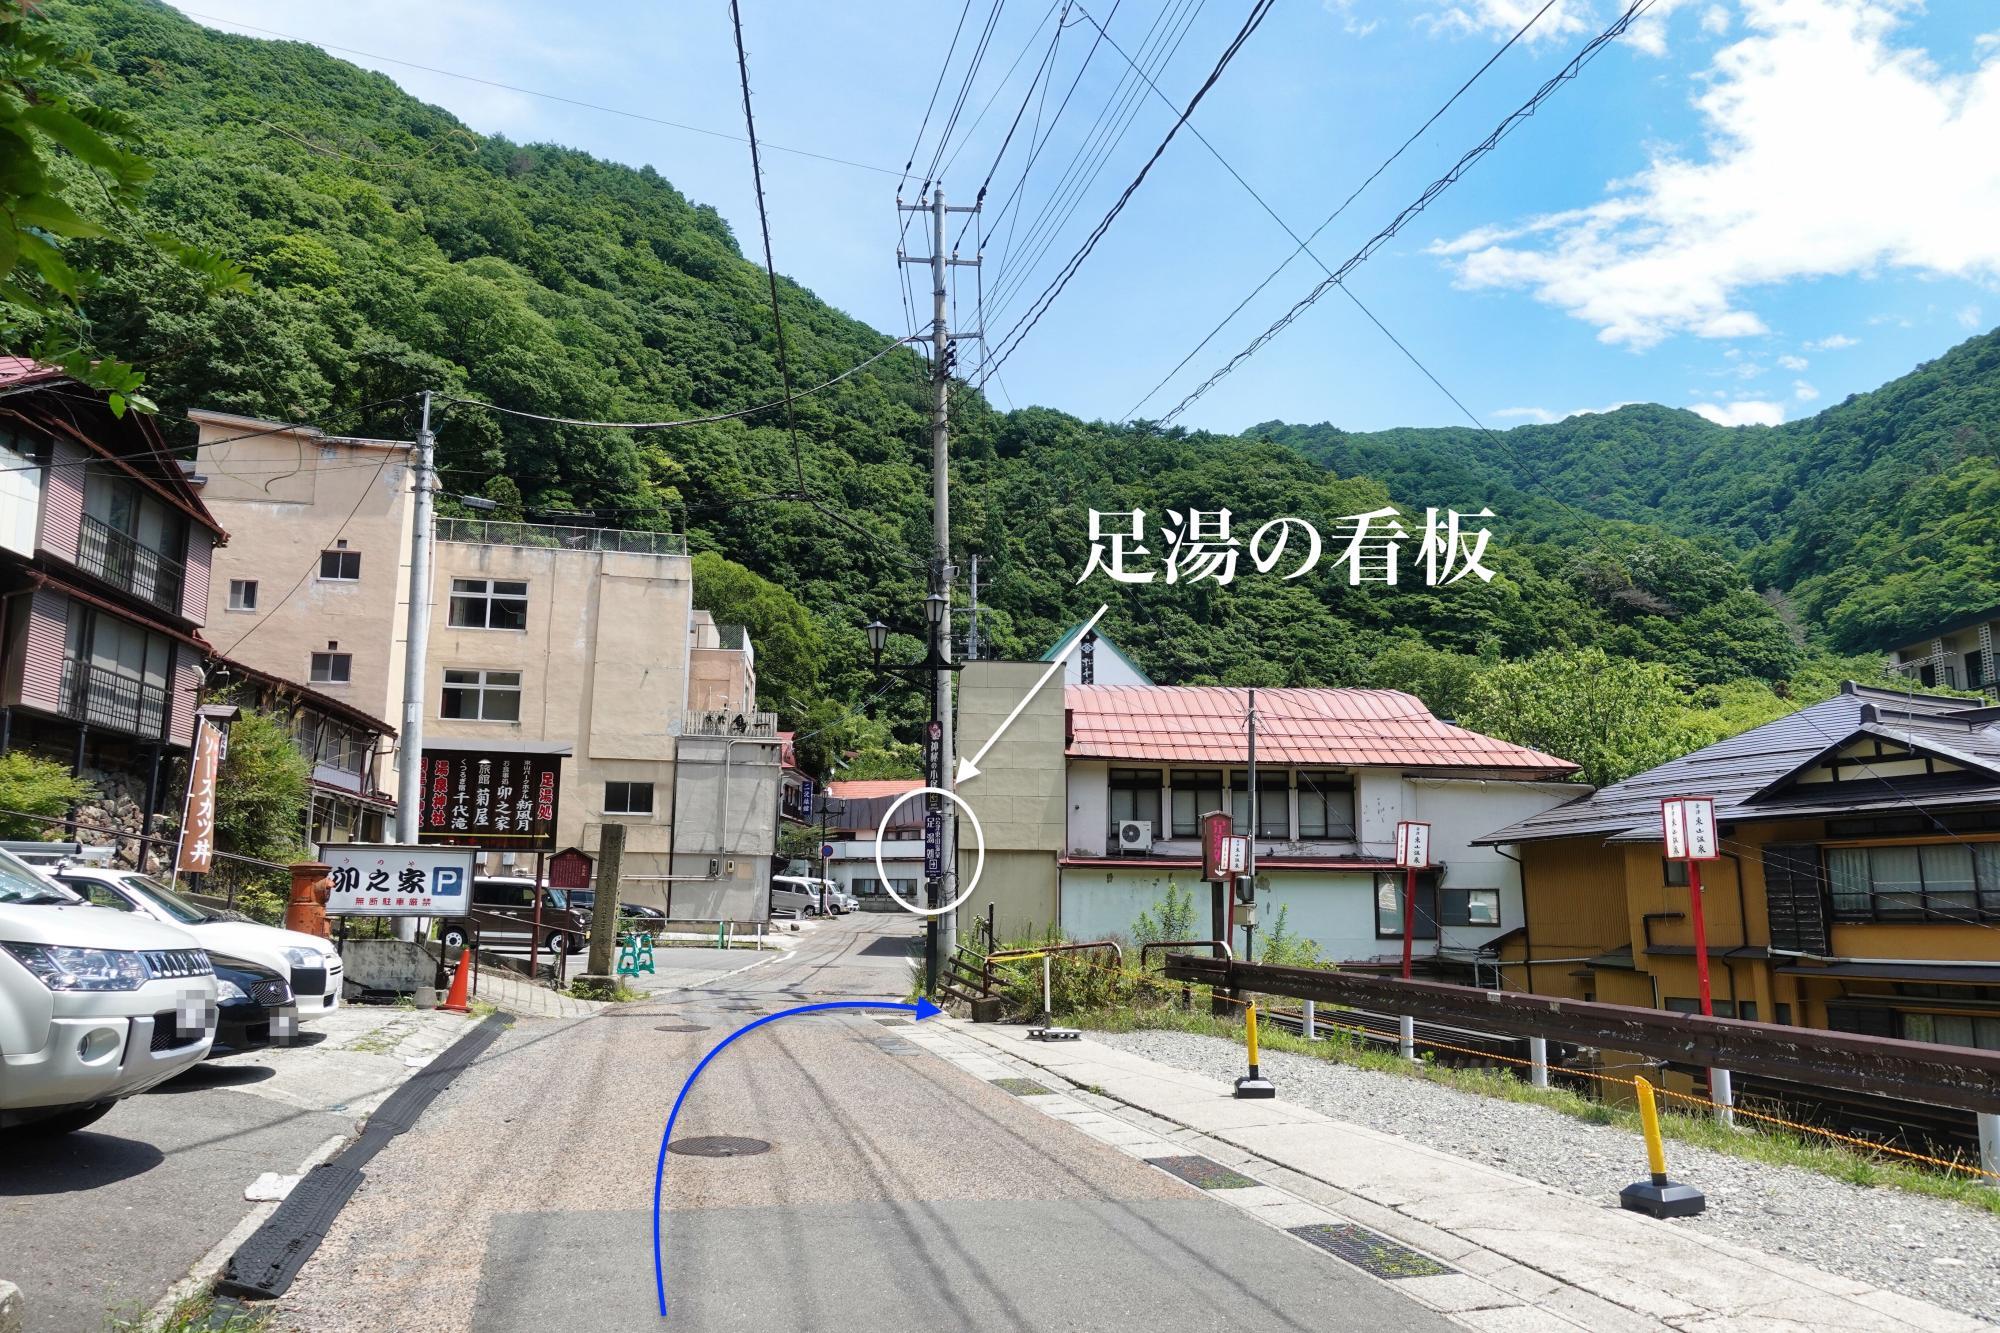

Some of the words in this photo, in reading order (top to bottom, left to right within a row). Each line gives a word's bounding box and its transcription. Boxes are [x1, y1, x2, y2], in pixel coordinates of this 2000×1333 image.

[478, 764, 491, 784] 旅館
[190, 736, 213, 865] ソースカツ丼
[451, 792, 470, 830] 千代滝
[473, 787, 490, 826] 菊屋
[495, 786, 513, 831] 卯之家
[537, 772, 553, 820] 足湯処
[516, 800, 533, 832] 新風月
[332, 866, 427, 894] 卯之家
[437, 870, 458, 893] P
[355, 897, 432, 907] 無断駐車厳禁
